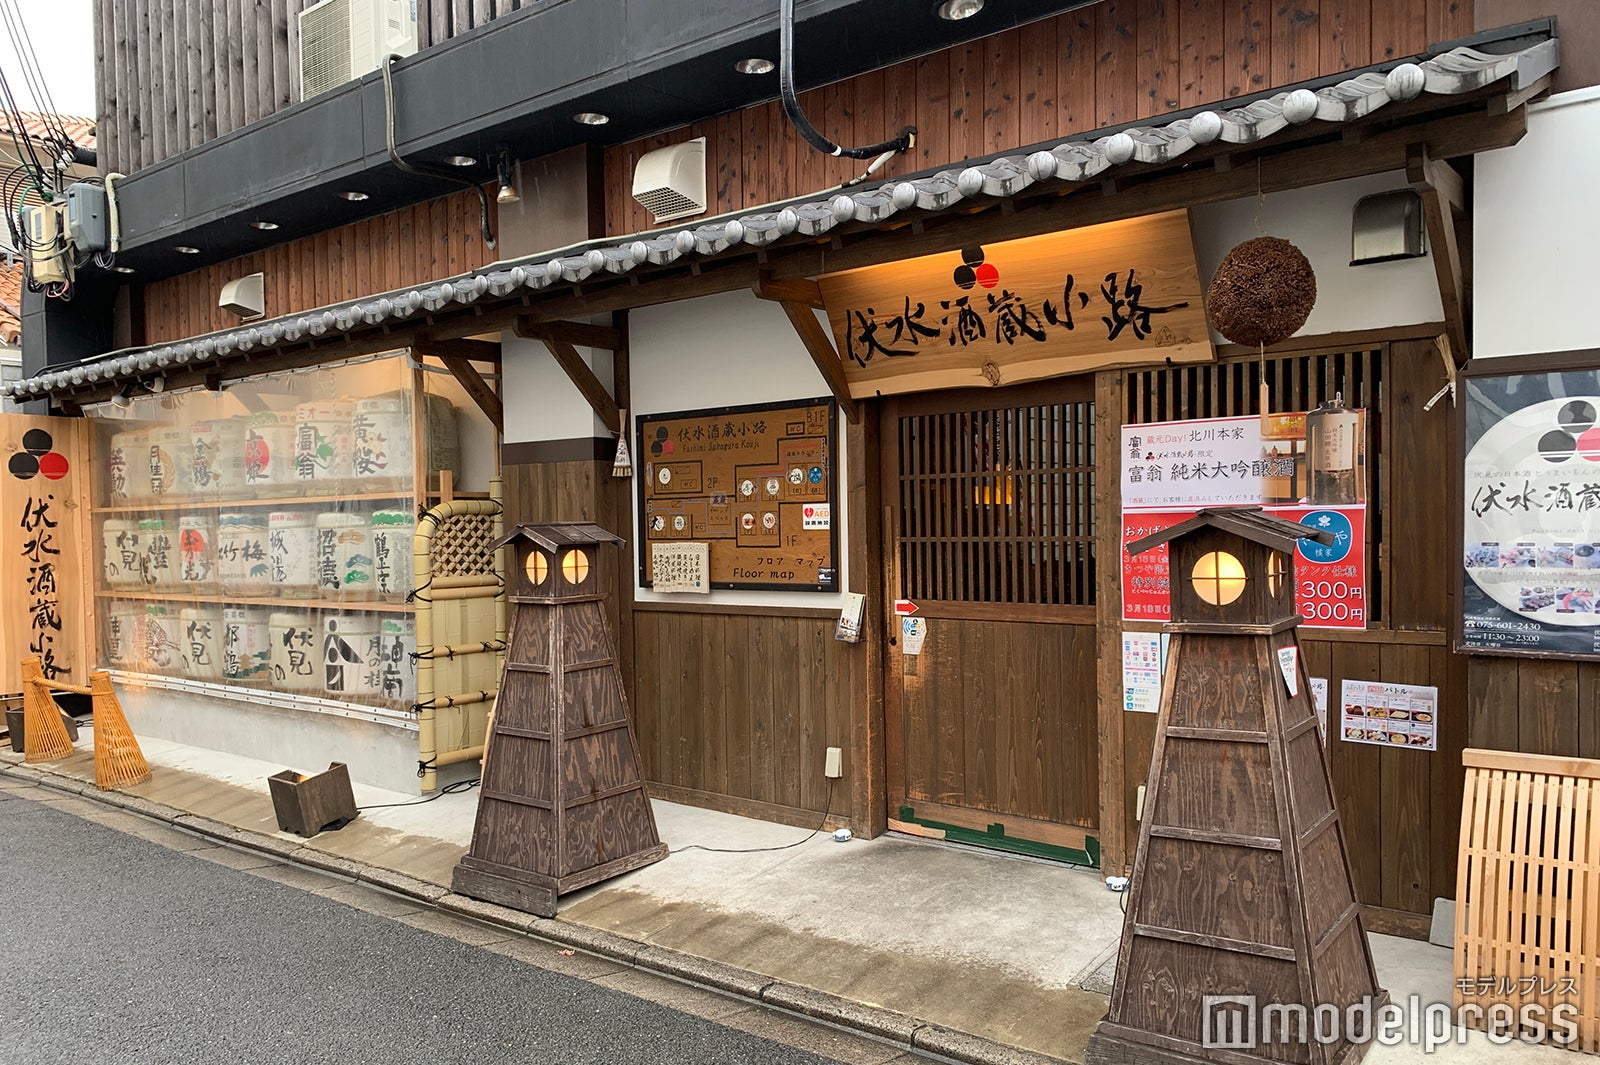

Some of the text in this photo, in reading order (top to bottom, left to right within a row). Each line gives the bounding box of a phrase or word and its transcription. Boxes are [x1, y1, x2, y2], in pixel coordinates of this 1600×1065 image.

[846, 269, 1190, 368] 伏水酒蔵小路
[807, 410, 826, 424] B1F
[678, 420, 768, 442] 伏水酒蔵小路
[1189, 427, 1245, 442] 北川本家
[298, 424, 319, 480] 富翁
[741, 438, 760, 451] Kouji
[1128, 457, 1295, 484] 富翁 純米大吟醸酒
[814, 510, 829, 519] AED
[757, 555, 826, 568] フロア マップ
[733, 567, 795, 581] Floor map
[1301, 580, 1363, 600] 300円
[1301, 601, 1364, 621] 300円
[1477, 621, 1541, 631] 075-601-2430
[186, 620, 212, 666] 伏見
[283, 627, 315, 676] 伏見
